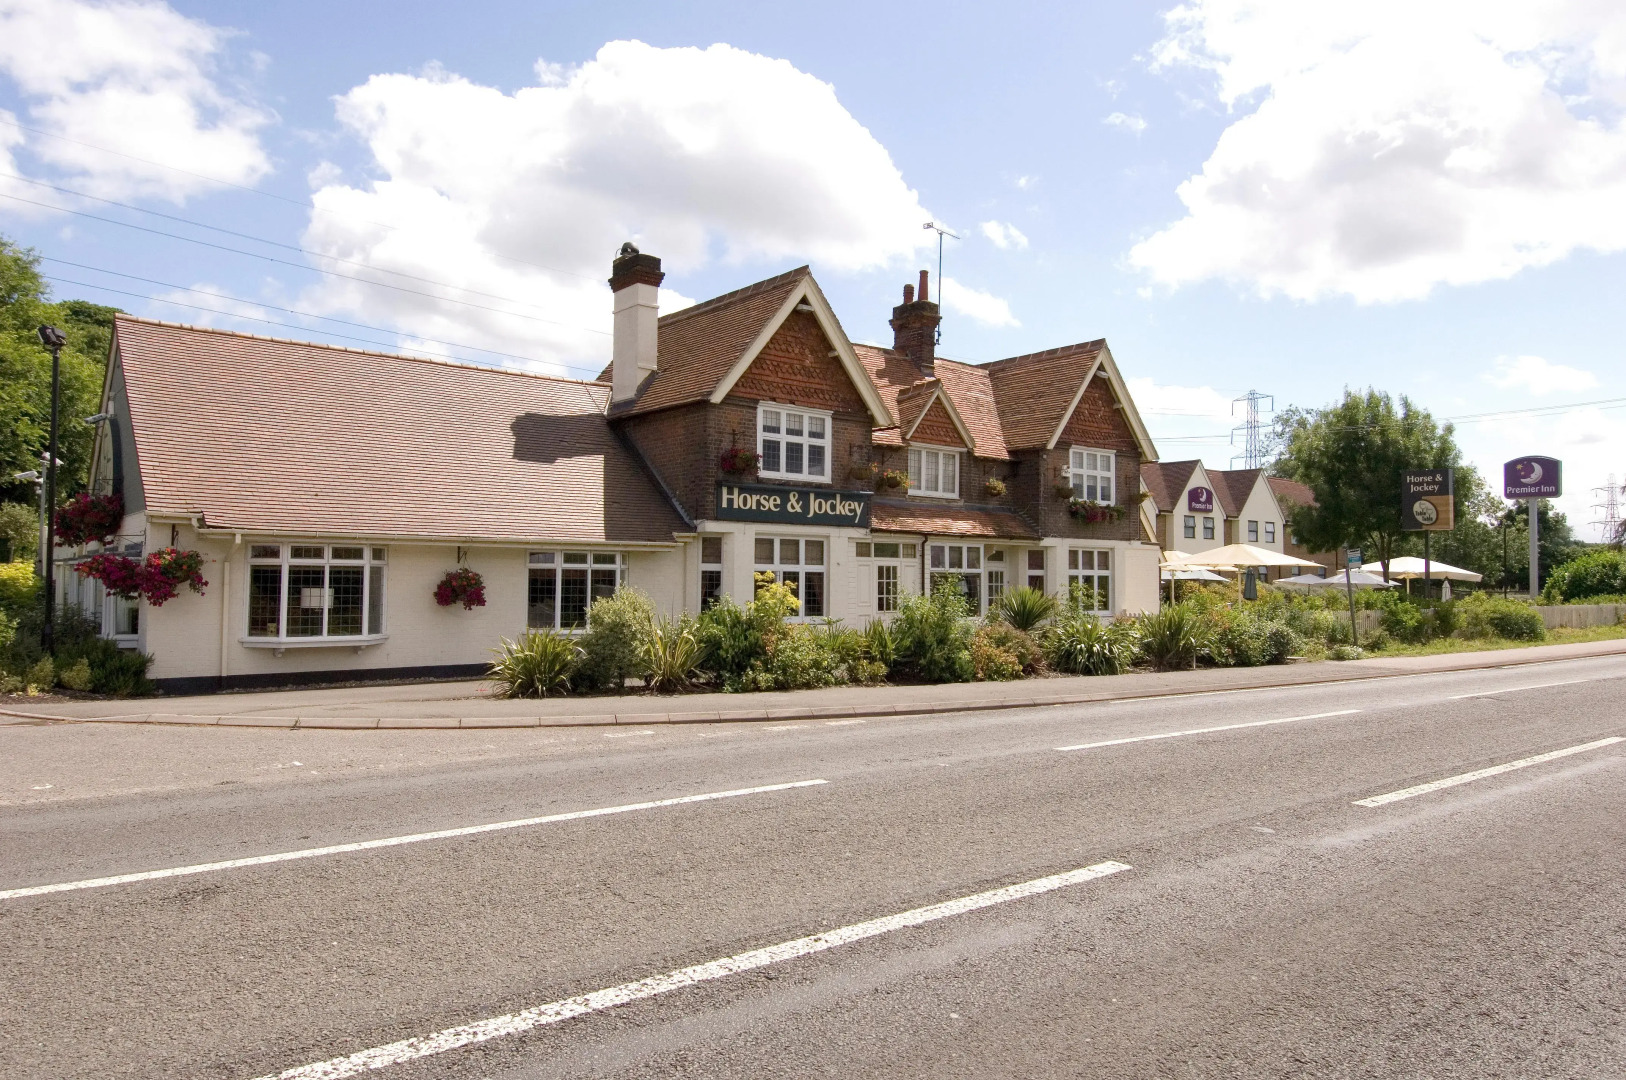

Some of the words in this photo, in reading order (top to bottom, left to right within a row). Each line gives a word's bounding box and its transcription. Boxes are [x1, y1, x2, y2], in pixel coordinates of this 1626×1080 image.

[1406, 475, 1433, 483] Horse
[1435, 473, 1443, 482] &
[1411, 483, 1439, 493] Jockey
[1507, 485, 1540, 493] Premier
[721, 486, 781, 512] Horse
[786, 491, 803, 513] &
[807, 492, 864, 524] Jockey
